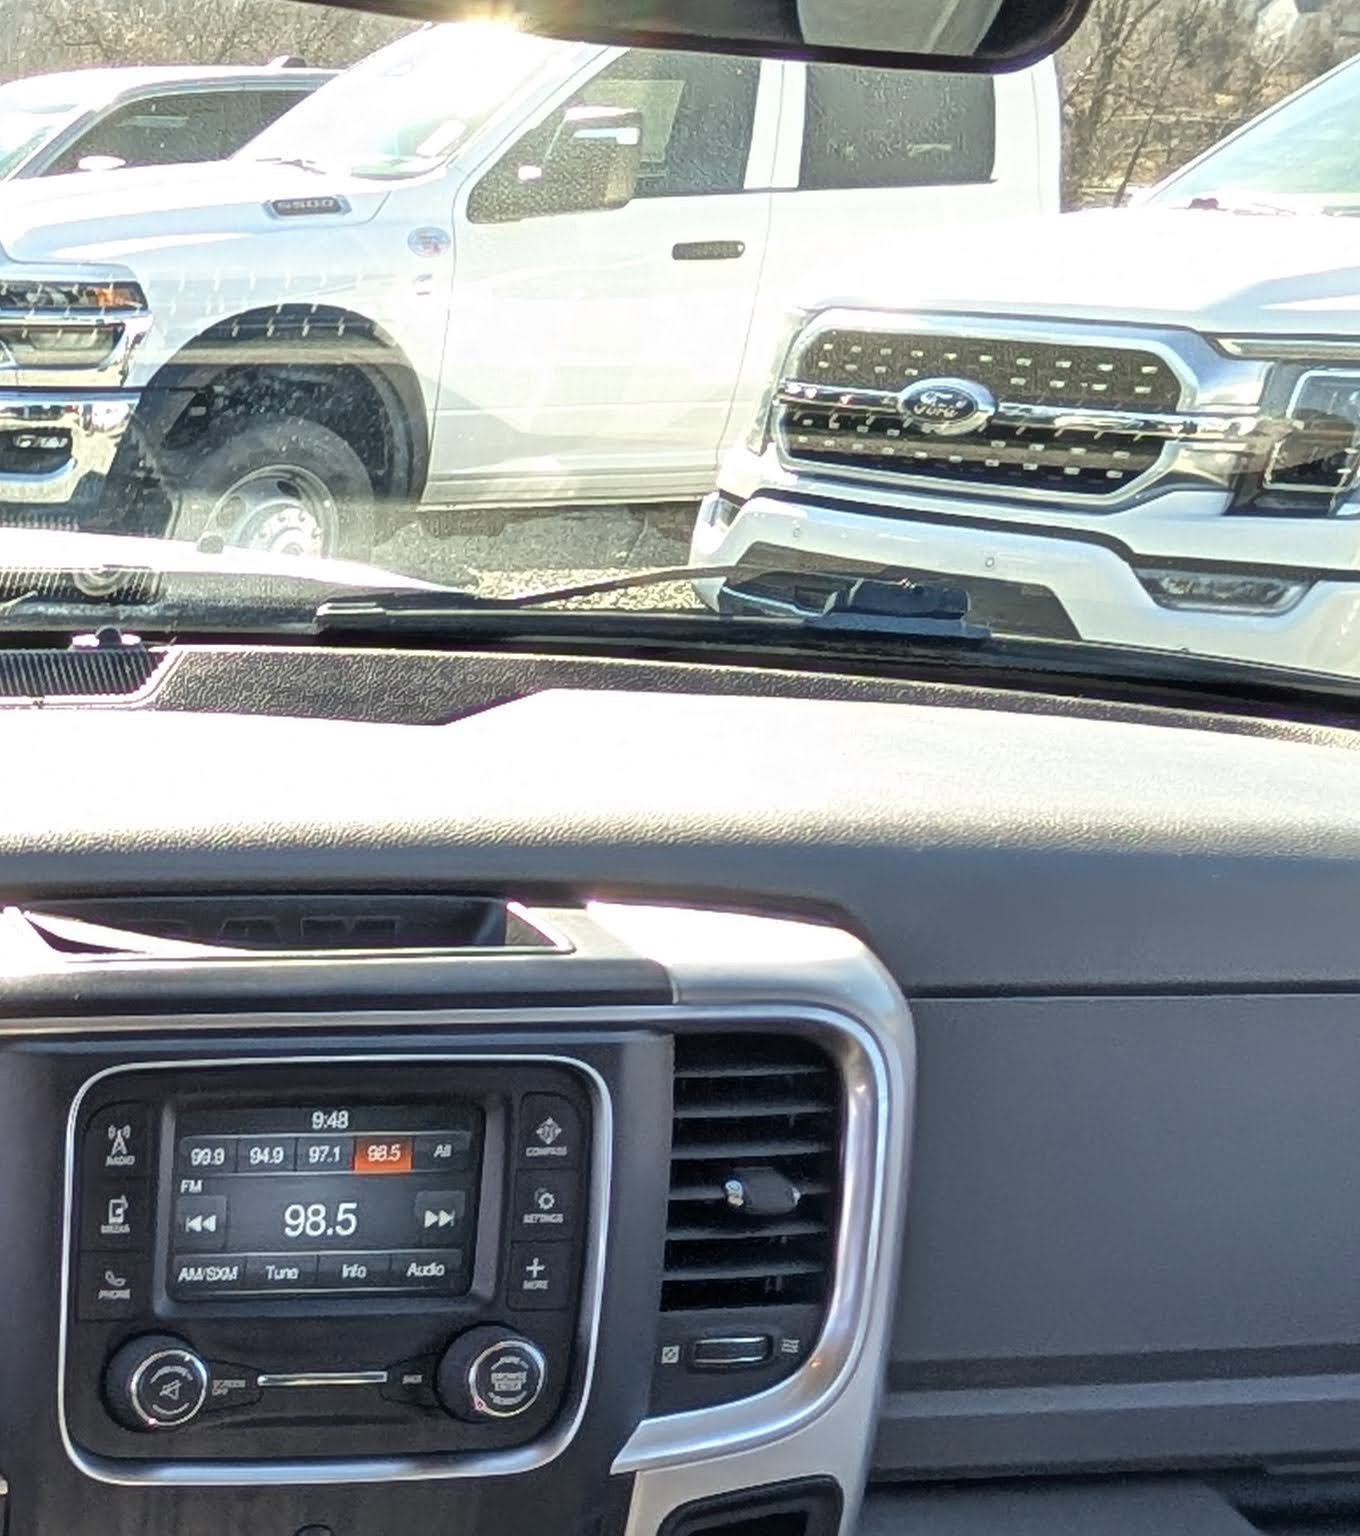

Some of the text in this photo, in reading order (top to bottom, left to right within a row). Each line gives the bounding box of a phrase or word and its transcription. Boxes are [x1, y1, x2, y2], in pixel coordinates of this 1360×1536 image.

[311, 1110, 349, 1130] 9:48
[308, 1145, 340, 1164] 97.1
[180, 1179, 203, 1193] FM
[284, 1203, 358, 1237] 98.5
[406, 1261, 445, 1278] Audio
